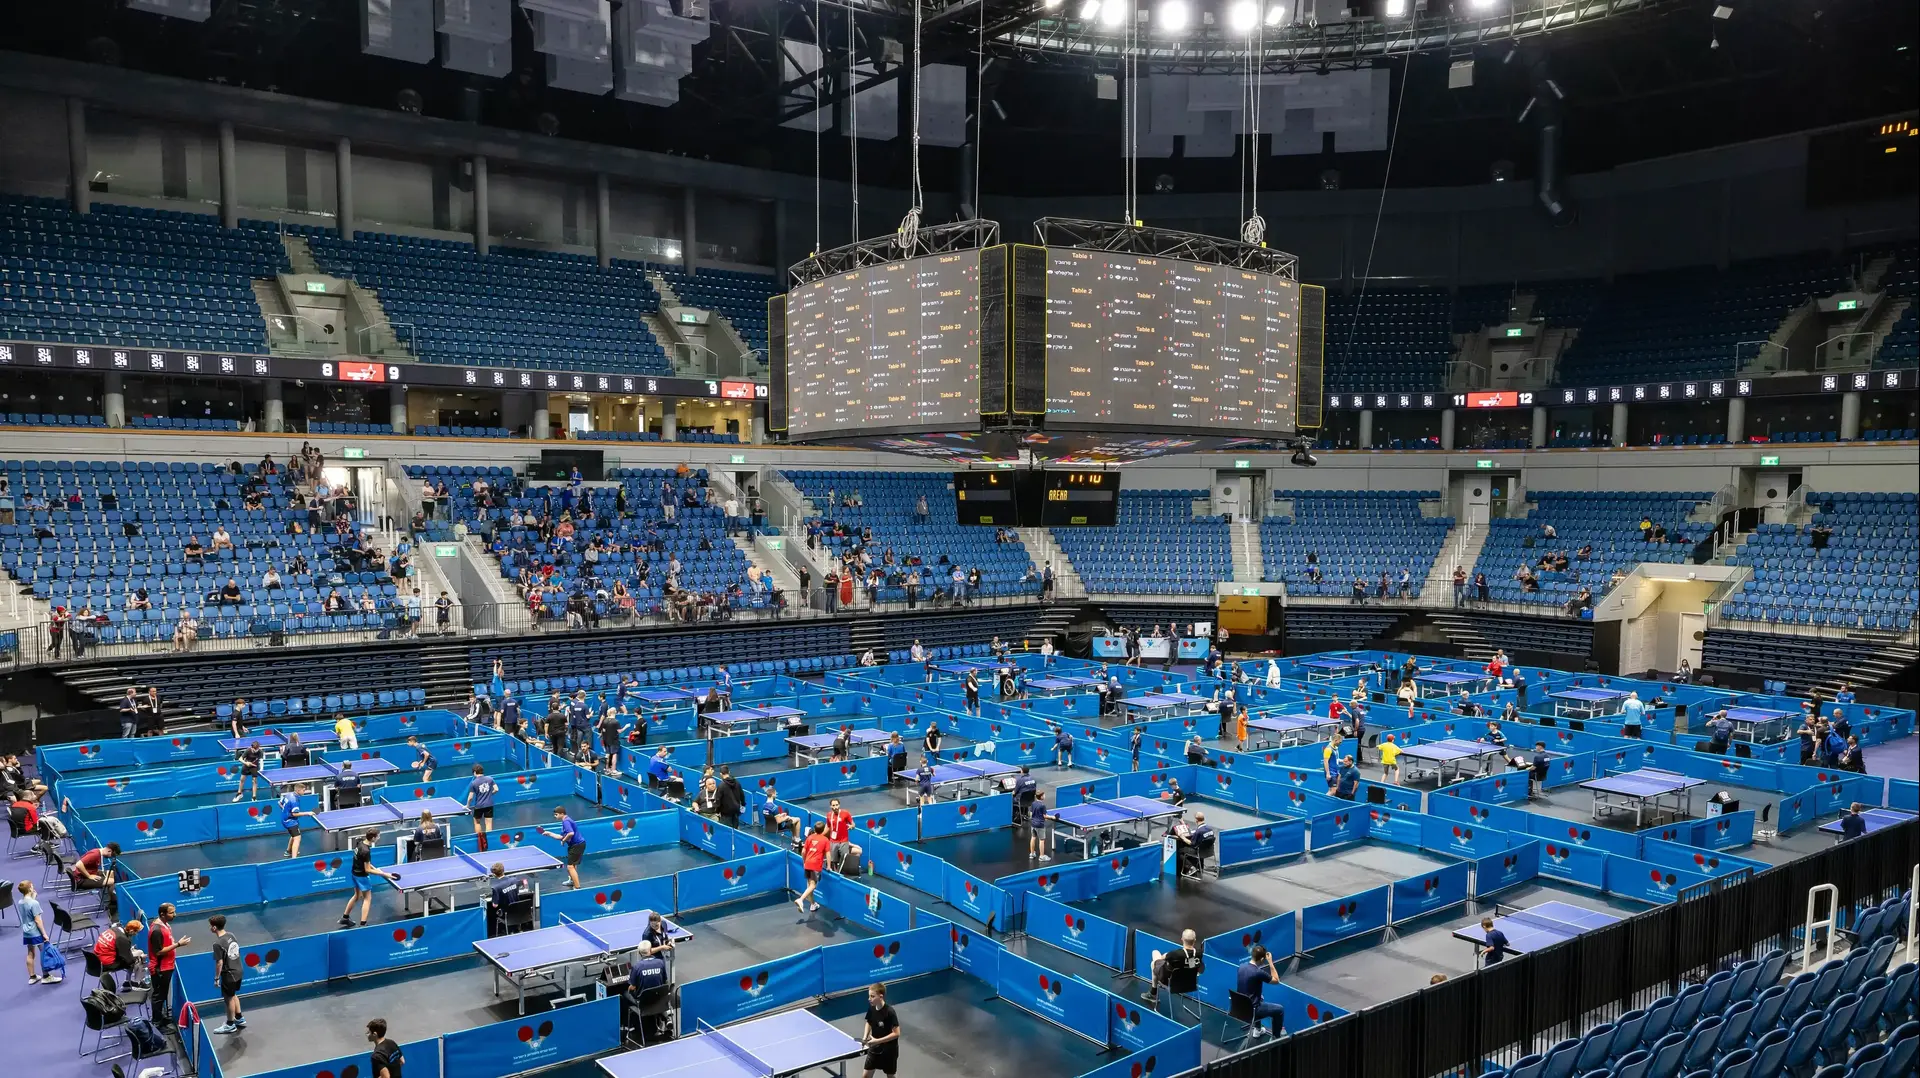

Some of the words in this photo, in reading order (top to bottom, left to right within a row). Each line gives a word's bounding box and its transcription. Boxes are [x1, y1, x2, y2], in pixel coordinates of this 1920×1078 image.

[322, 363, 332, 376] 8
[389, 366, 399, 379] 9
[709, 384, 717, 394] 9
[755, 385, 767, 396] 10
[1454, 395, 1464, 405] 11
[1519, 393, 1532, 403] 12
[1049, 490, 1067, 500] ARENA
